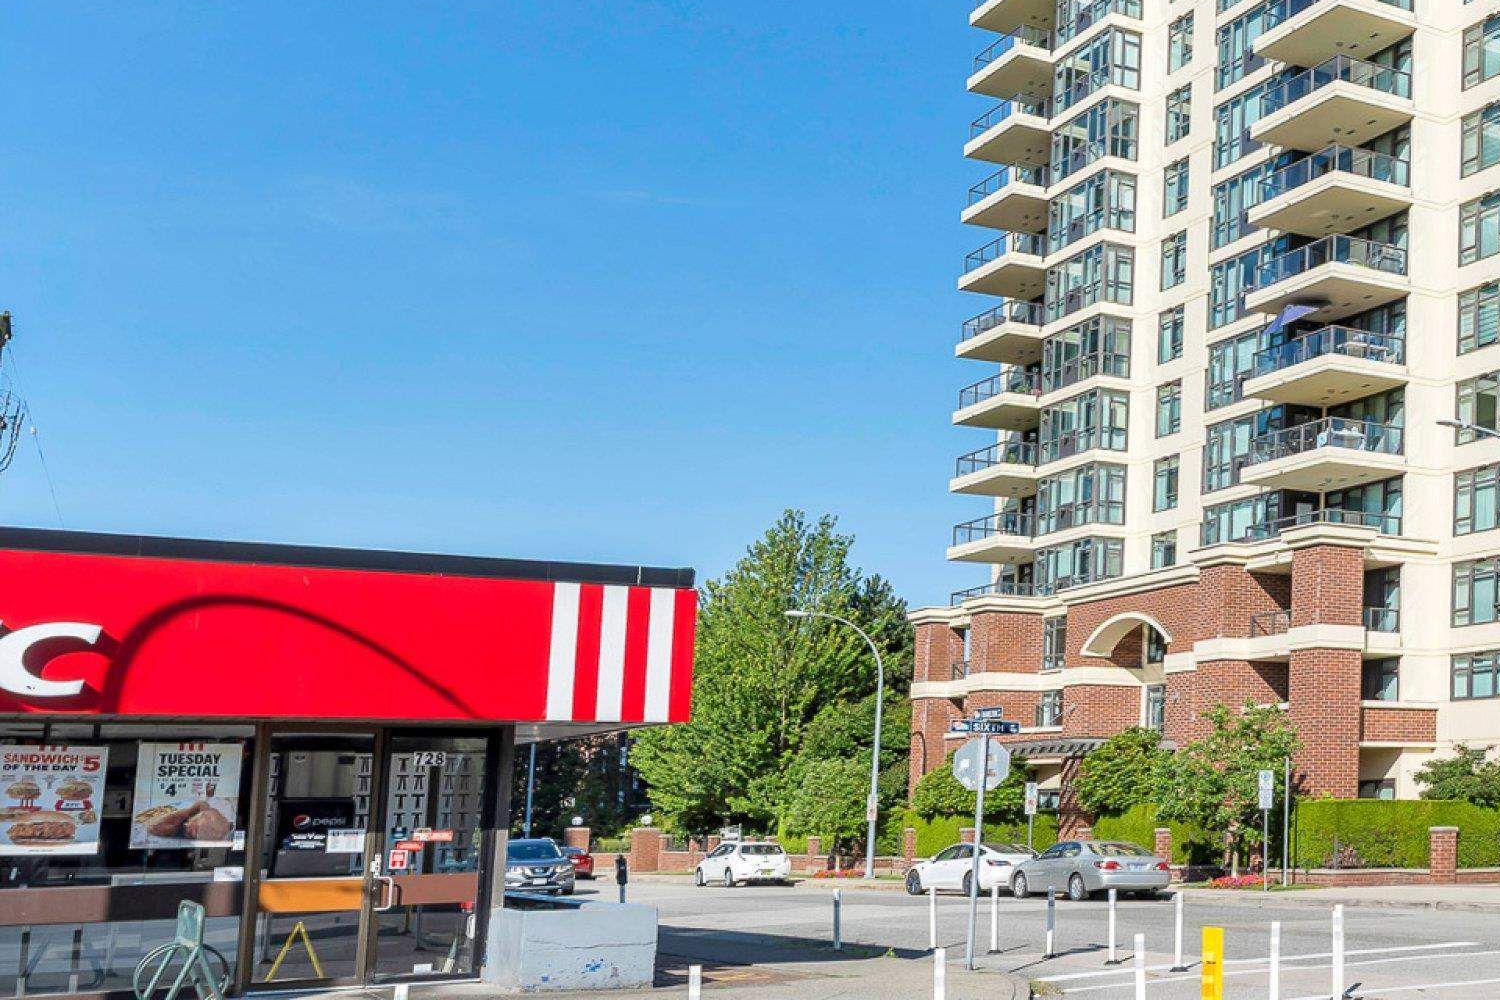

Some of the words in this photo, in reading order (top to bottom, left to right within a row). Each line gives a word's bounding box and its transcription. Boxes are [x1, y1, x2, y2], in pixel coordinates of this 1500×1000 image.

[973, 723, 1004, 731] SIXTH
[4, 752, 79, 764] SANDWICH
[158, 752, 222, 765] TUESDAY
[414, 752, 446, 766] 728
[3, 763, 19, 771] OF
[24, 763, 48, 771] THE
[52, 763, 77, 772] DAY
[157, 765, 221, 777] SPECIAL
